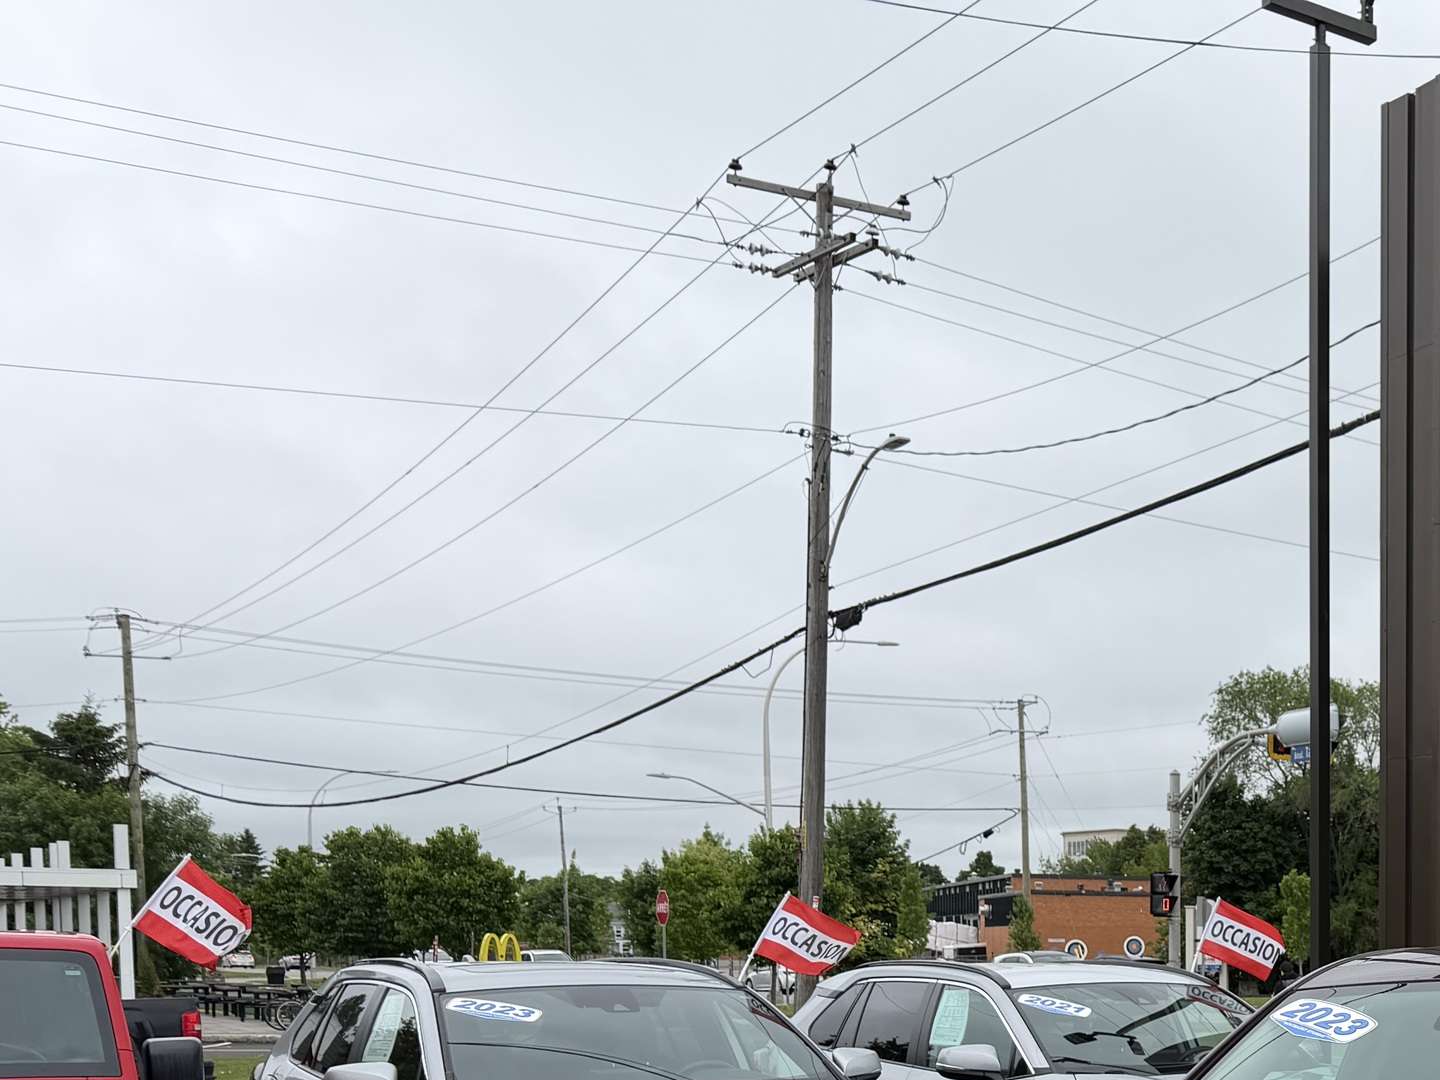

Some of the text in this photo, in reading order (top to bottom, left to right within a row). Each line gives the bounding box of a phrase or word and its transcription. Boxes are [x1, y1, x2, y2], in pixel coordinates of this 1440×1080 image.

[160, 886, 247, 951] OCCASIO
[453, 999, 535, 1018] 2023
[1024, 996, 1086, 1013] 2021
[1280, 1002, 1369, 1036] 2023
